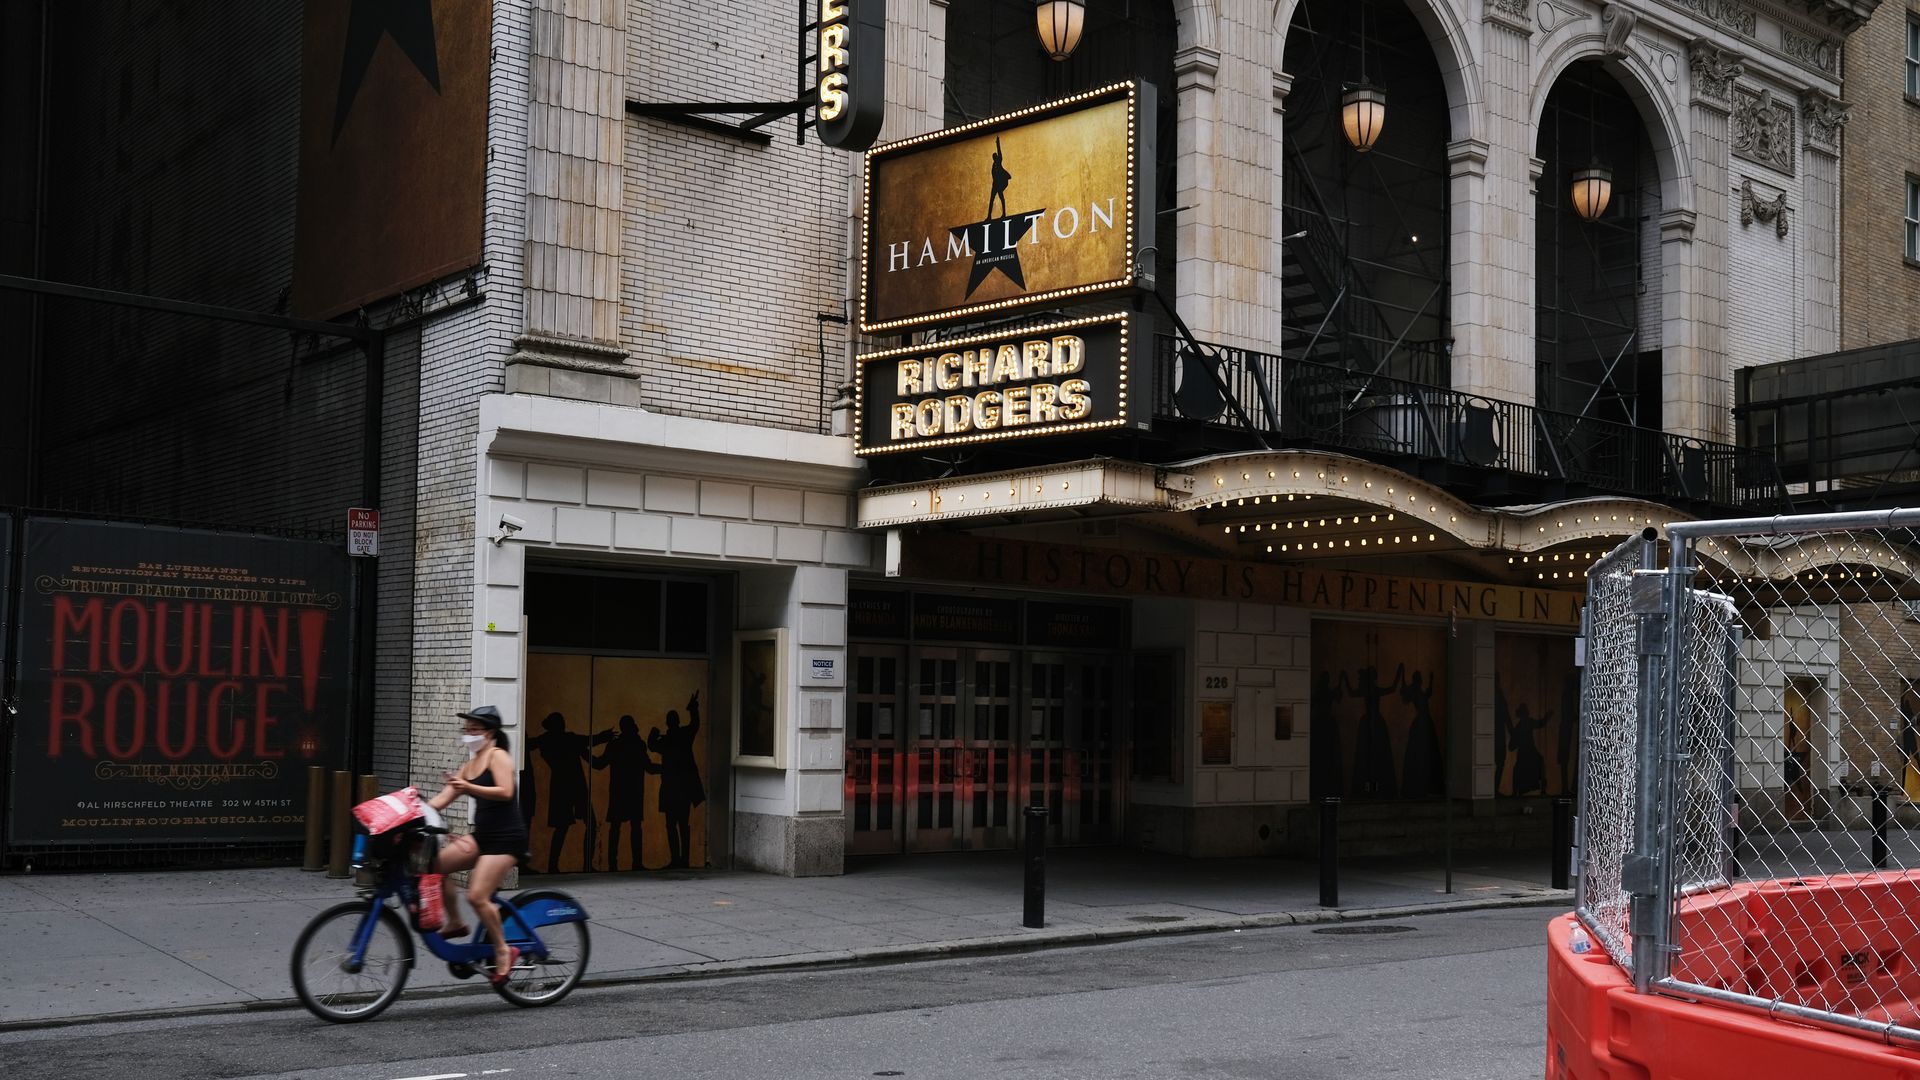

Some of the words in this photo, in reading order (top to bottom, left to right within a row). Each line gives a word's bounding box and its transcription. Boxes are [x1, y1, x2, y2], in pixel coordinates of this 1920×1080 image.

[888, 198, 1115, 273] HAMILTON
[982, 256, 999, 264] AMERICAN
[897, 334, 1087, 396] RICHARD
[890, 379, 1092, 441] RODGERS
[358, 511, 370, 519] NO
[351, 519, 376, 529] PARKING
[71, 565, 180, 581] REVOLUTIONARY
[183, 572, 214, 580] FILM
[218, 574, 258, 583] COMES
[279, 578, 307, 586] LIFE
[138, 562, 164, 570] BAZ
[166, 564, 249, 575] LUHRMANN'S
[976, 541, 1194, 594] HISTORY
[1220, 565, 1255, 599] IS
[1283, 569, 1497, 617] HAPPENING
[1518, 590, 1550, 619] IN
[70, 580, 120, 595] TRUTH
[135, 583, 191, 598] BEAUTY
[205, 587, 269, 602] FREEDOM
[53, 596, 289, 679] MOULIN
[1206, 676, 1229, 689] 226
[129, 764, 163, 777] THE
[87, 801, 100, 809] AL
[103, 800, 167, 809] HIRSCHFELD
[169, 799, 213, 809] THEATRE
[222, 799, 240, 808] 302
[242, 799, 252, 808] W
[254, 799, 279, 808] 45TH
[280, 799, 292, 808] ST
[61, 814, 305, 828] MOULINROUGEMUSICAL.COM
